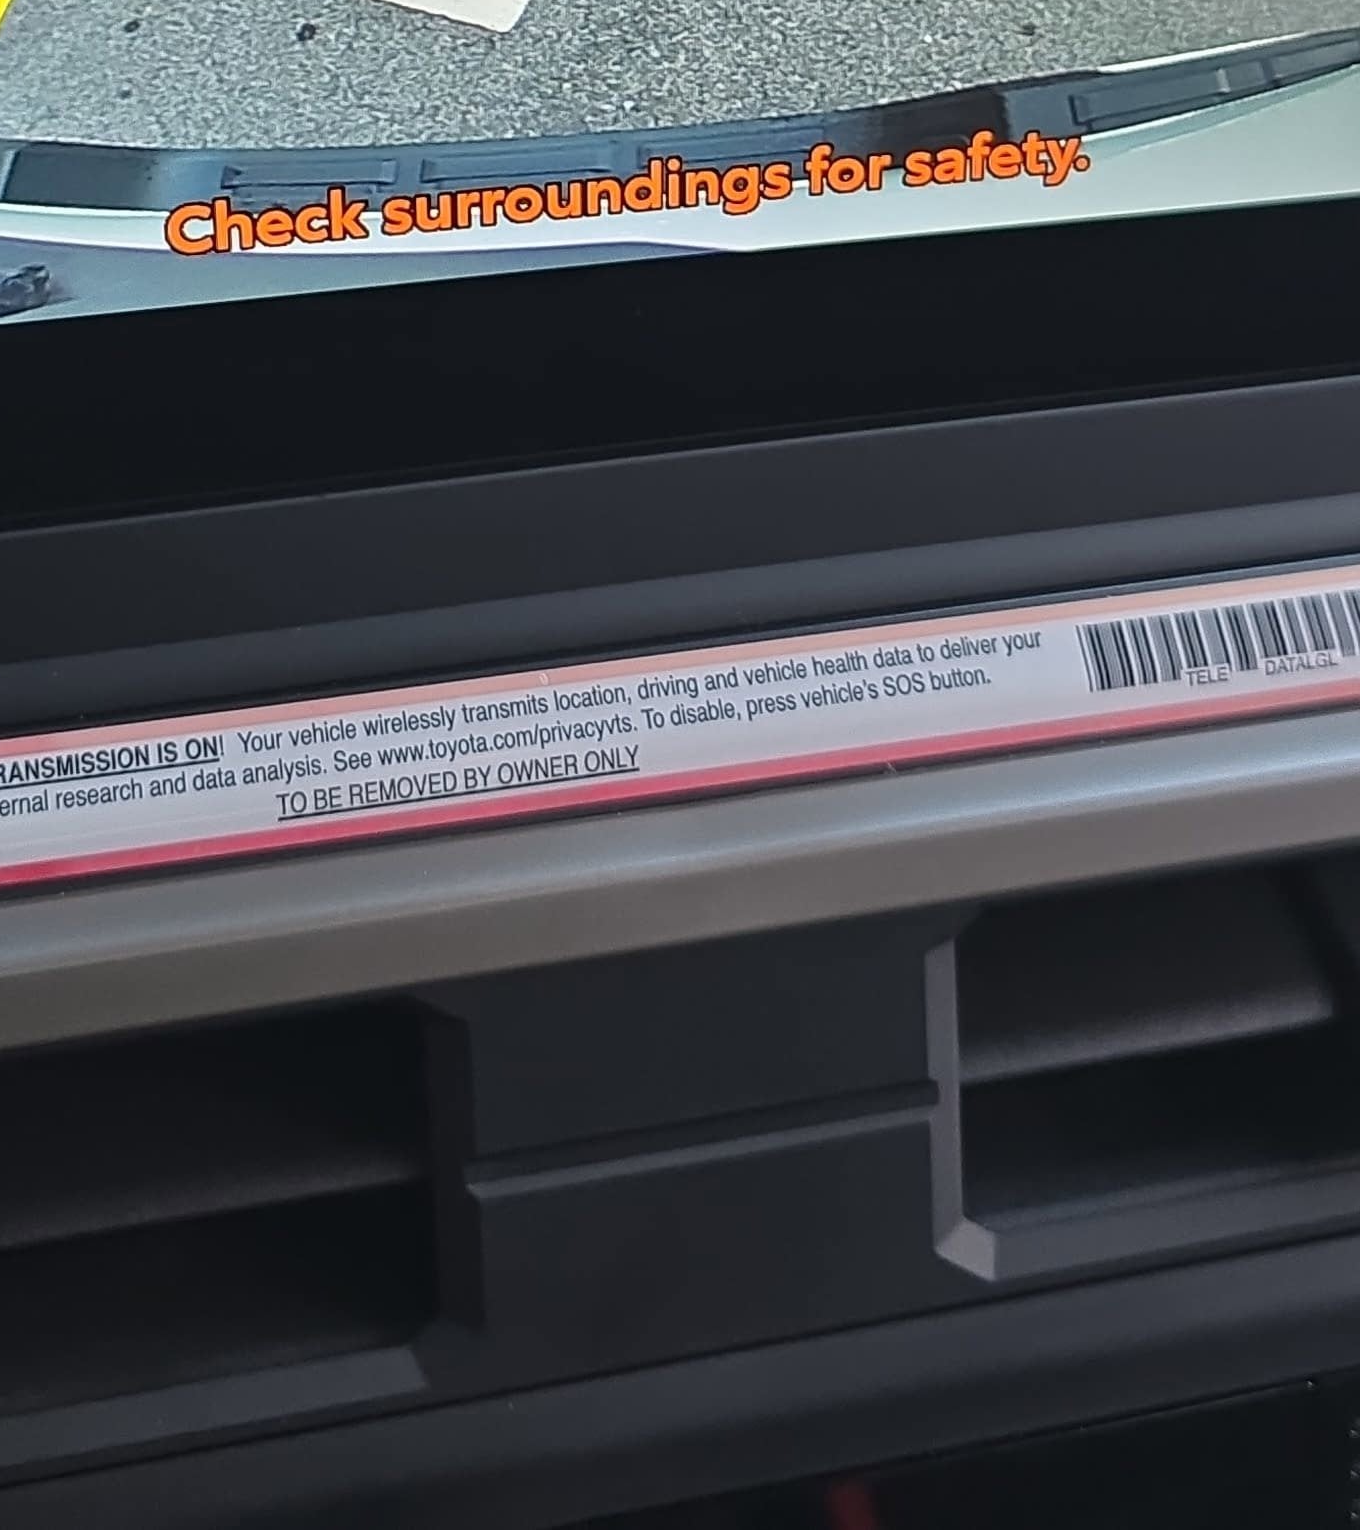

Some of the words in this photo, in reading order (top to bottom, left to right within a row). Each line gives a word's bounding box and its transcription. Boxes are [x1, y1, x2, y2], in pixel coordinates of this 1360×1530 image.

[164, 184, 369, 257] Check
[381, 156, 793, 236] surroundings
[806, 143, 892, 195] for
[903, 129, 1091, 189] safety.
[55, 778, 143, 809] research
[149, 772, 187, 797] and
[192, 768, 236, 791] data
[242, 754, 327, 785] analysis.
[333, 749, 372, 772] See
[377, 714, 638, 765] www.toyota.com/privacyvts.
[641, 707, 665, 730] To
[669, 698, 741, 726] disable,
[745, 691, 797, 721] press
[800, 678, 879, 710] vehicle's
[882, 672, 926, 697] SOS
[929, 667, 992, 691] button.
[157, 741, 178, 764] IS
[185, 734, 225, 760] ON!
[237, 730, 283, 754] Your
[288, 719, 357, 747] vehicle
[362, 705, 456, 737] wirelessly
[461, 694, 549, 723] transmits
[553, 684, 632, 712] location,
[637, 674, 699, 700] driving
[704, 666, 739, 691] and
[742, 658, 808, 686] vehicle
[811, 650, 869, 677] health
[873, 647, 913, 669] data
[919, 643, 935, 663] to
[940, 635, 998, 660] deliver
[1002, 630, 1042, 657] your
[1185, 667, 1228, 686] TELE
[276, 791, 308, 815] TO
[313, 786, 343, 811] BE
[349, 770, 458, 806] REMOVED
[463, 765, 492, 790] BY
[497, 754, 578, 785] OWNER
[584, 744, 640, 772] ONLY
